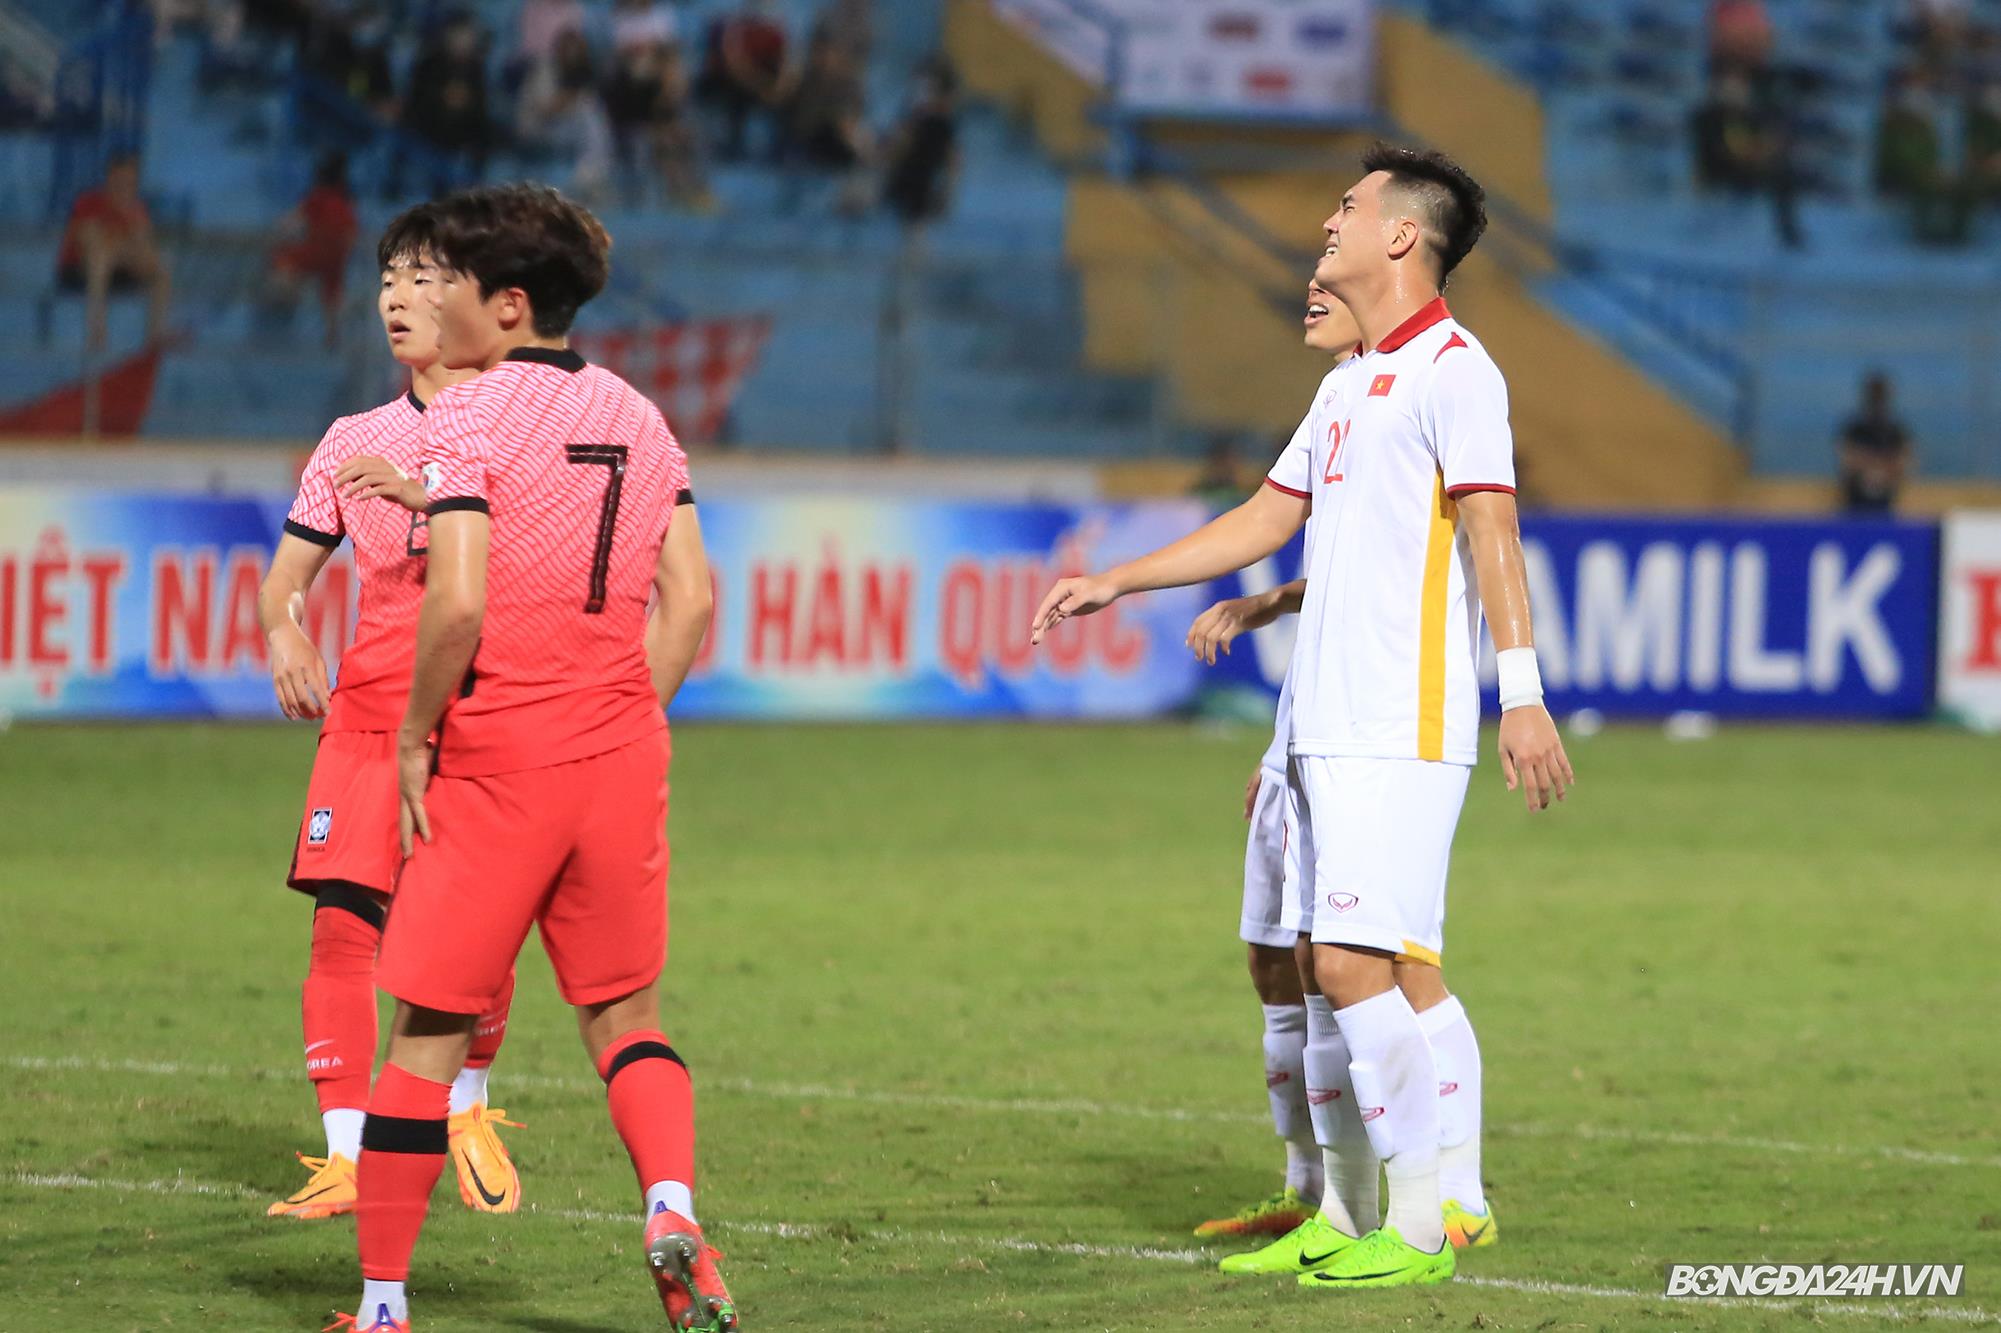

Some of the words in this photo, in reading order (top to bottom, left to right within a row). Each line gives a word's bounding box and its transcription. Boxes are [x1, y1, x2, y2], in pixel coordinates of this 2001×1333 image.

[0, 528, 124, 699] IỆT
[748, 532, 912, 674] HÀN
[565, 443, 628, 614] 7
